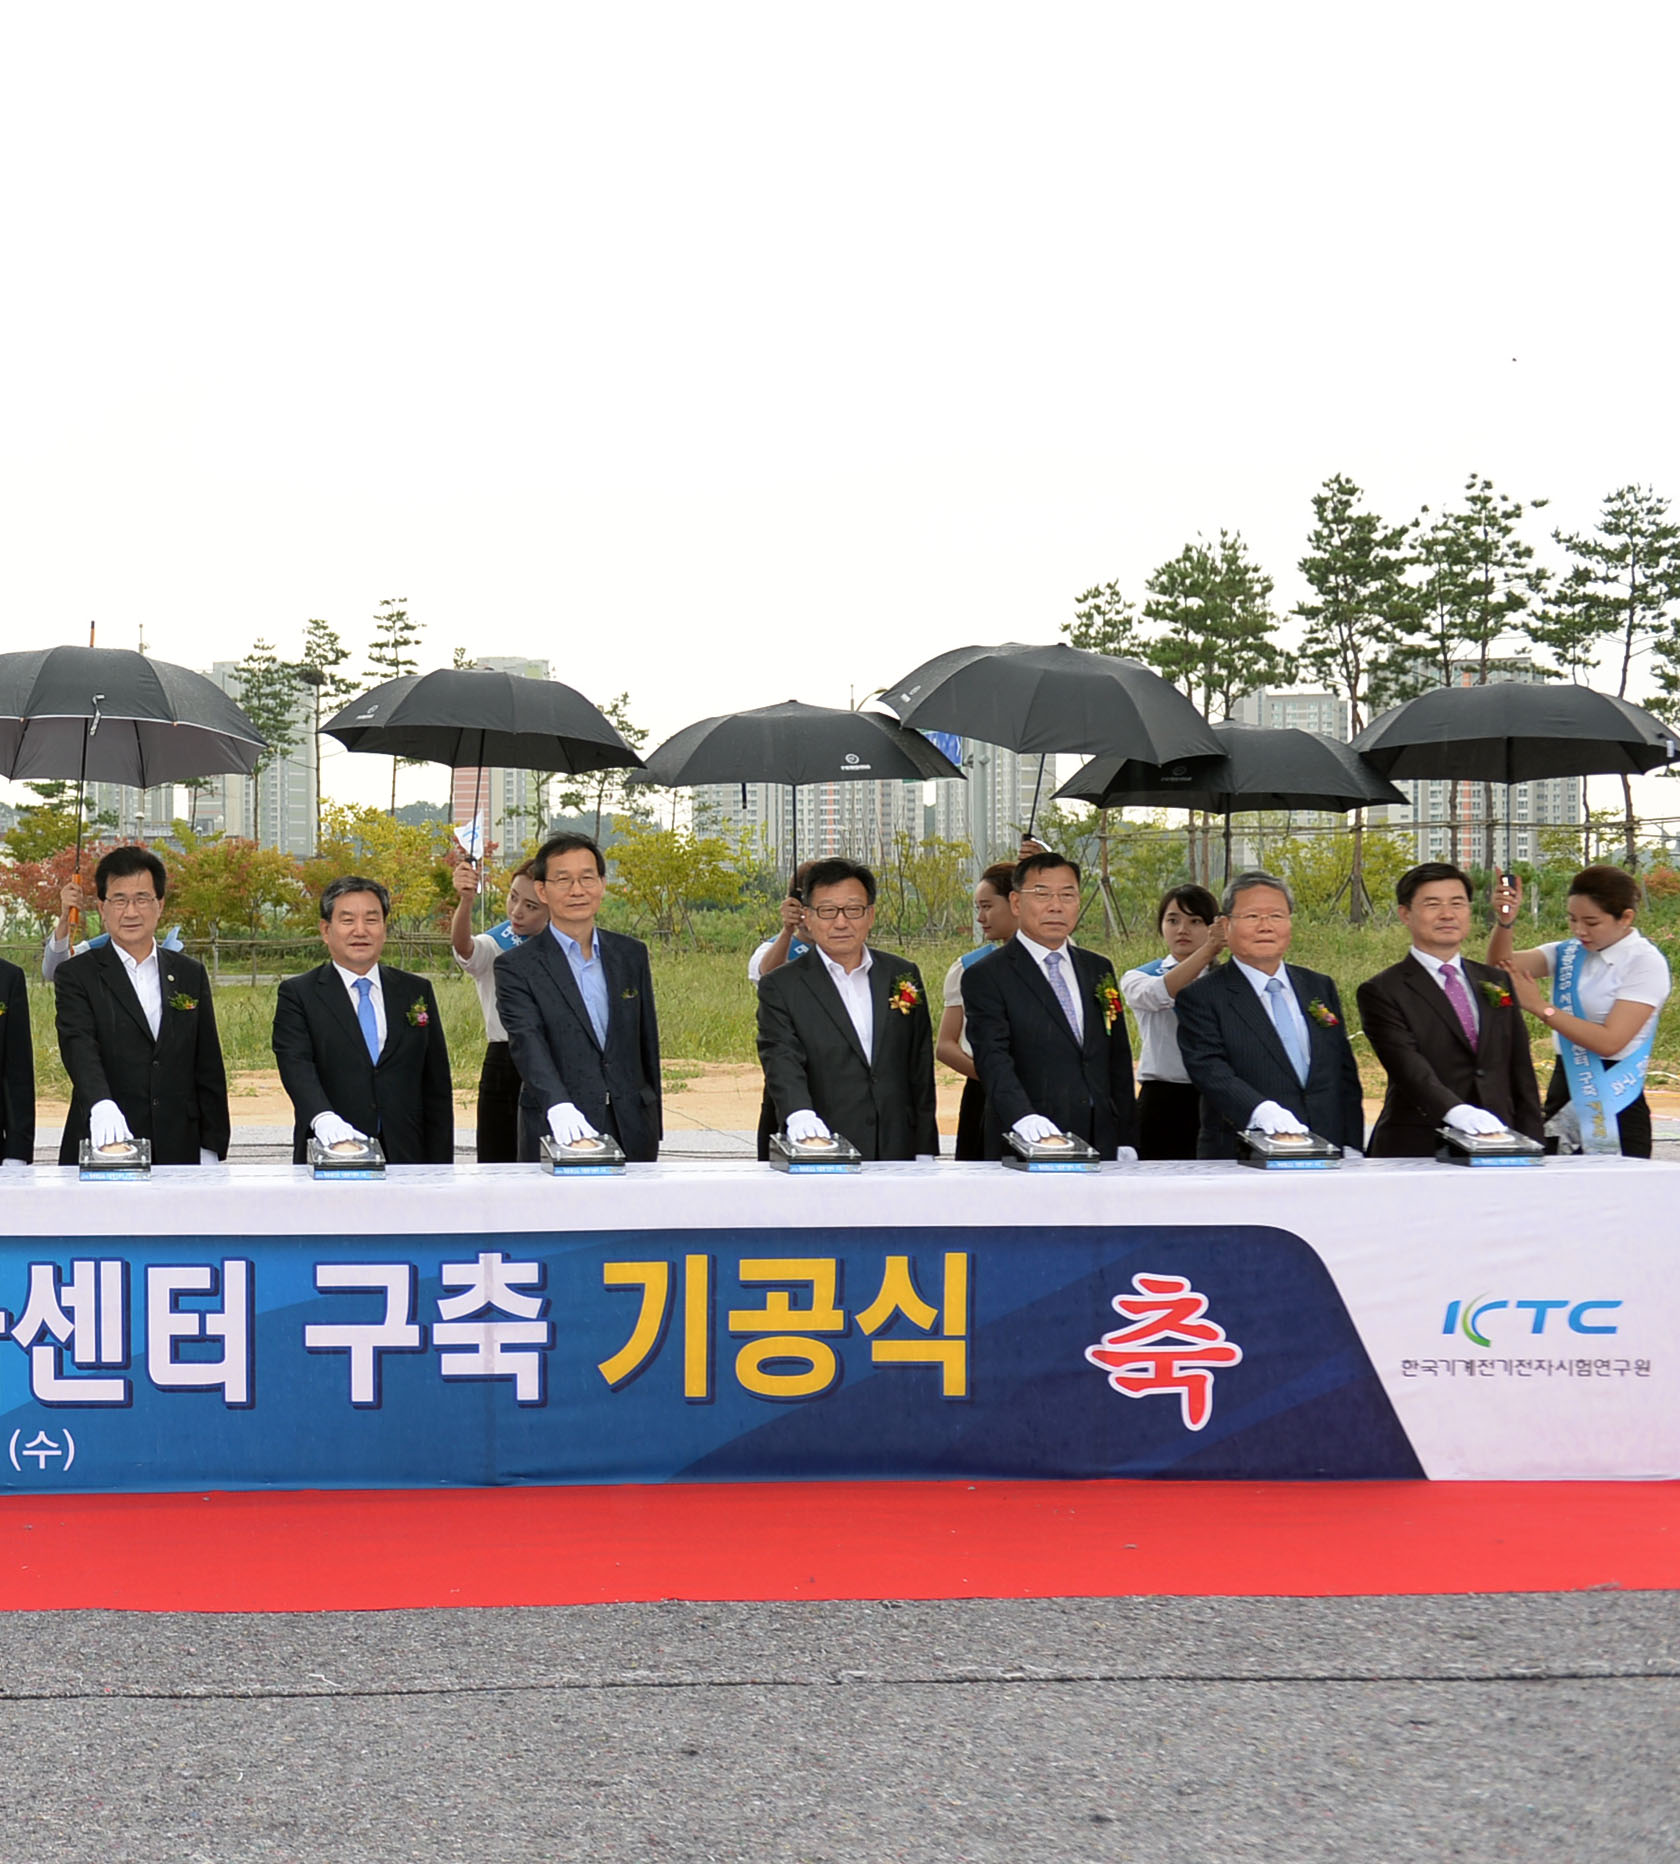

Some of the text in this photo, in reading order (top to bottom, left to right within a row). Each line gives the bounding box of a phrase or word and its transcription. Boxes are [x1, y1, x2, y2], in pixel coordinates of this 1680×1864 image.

[304, 1252, 549, 1403] 구축
[597, 1252, 968, 1399] 기공식
[1442, 1292, 1624, 1348] KTC
[1085, 1273, 1243, 1431] 축
[1401, 1358, 1651, 1377] 한국기계전기전자시험연구원
[8, 1428, 75, 1472] (수)
